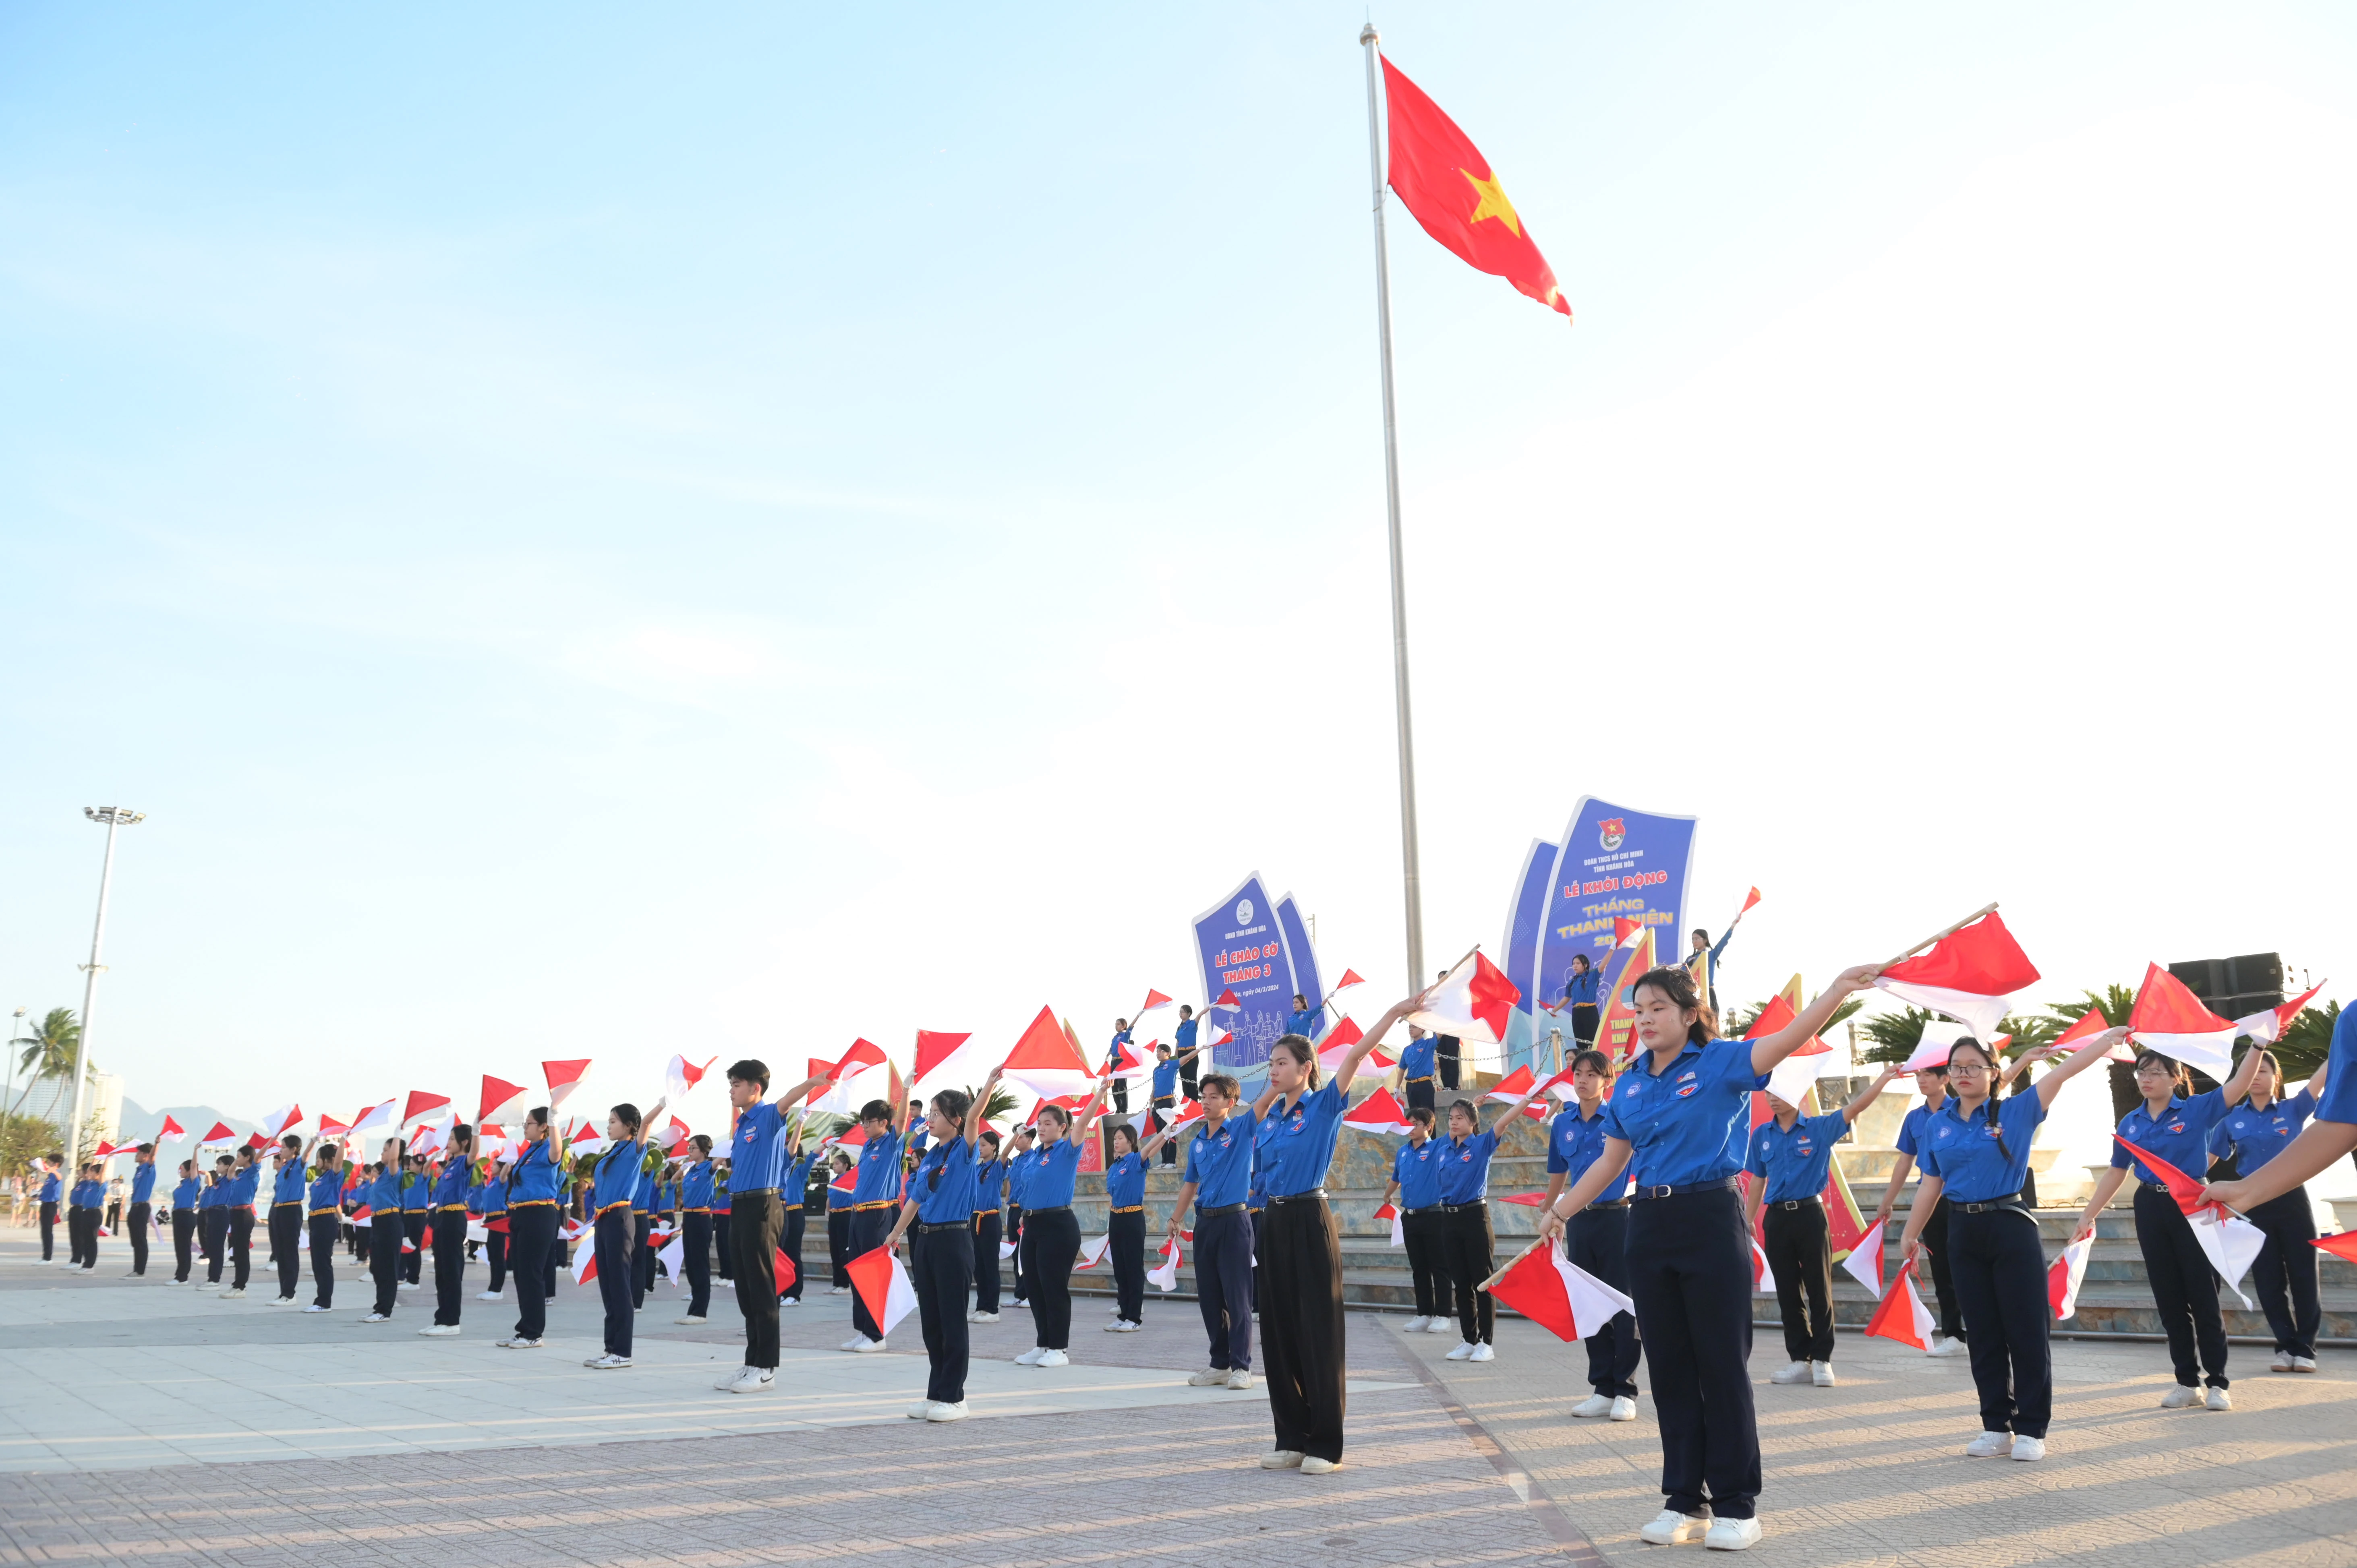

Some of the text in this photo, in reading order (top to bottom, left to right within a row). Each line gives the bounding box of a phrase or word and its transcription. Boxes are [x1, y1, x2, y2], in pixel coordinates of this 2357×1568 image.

[1630, 850, 1643, 858] MINH
[1606, 862, 1622, 871] KHÁNH
[1564, 870, 1667, 898] LỄ KHỞI ĐỘNG
[1583, 896, 1644, 916] THÁNG
[1245, 927, 1257, 935] KHÁNH
[1216, 941, 1278, 967] LỄ CHÀO CỜ
[1223, 963, 1271, 984] THÁNG 3
[1243, 989, 1254, 997] ngày
[1255, 984, 1279, 994] 04/3/2024
